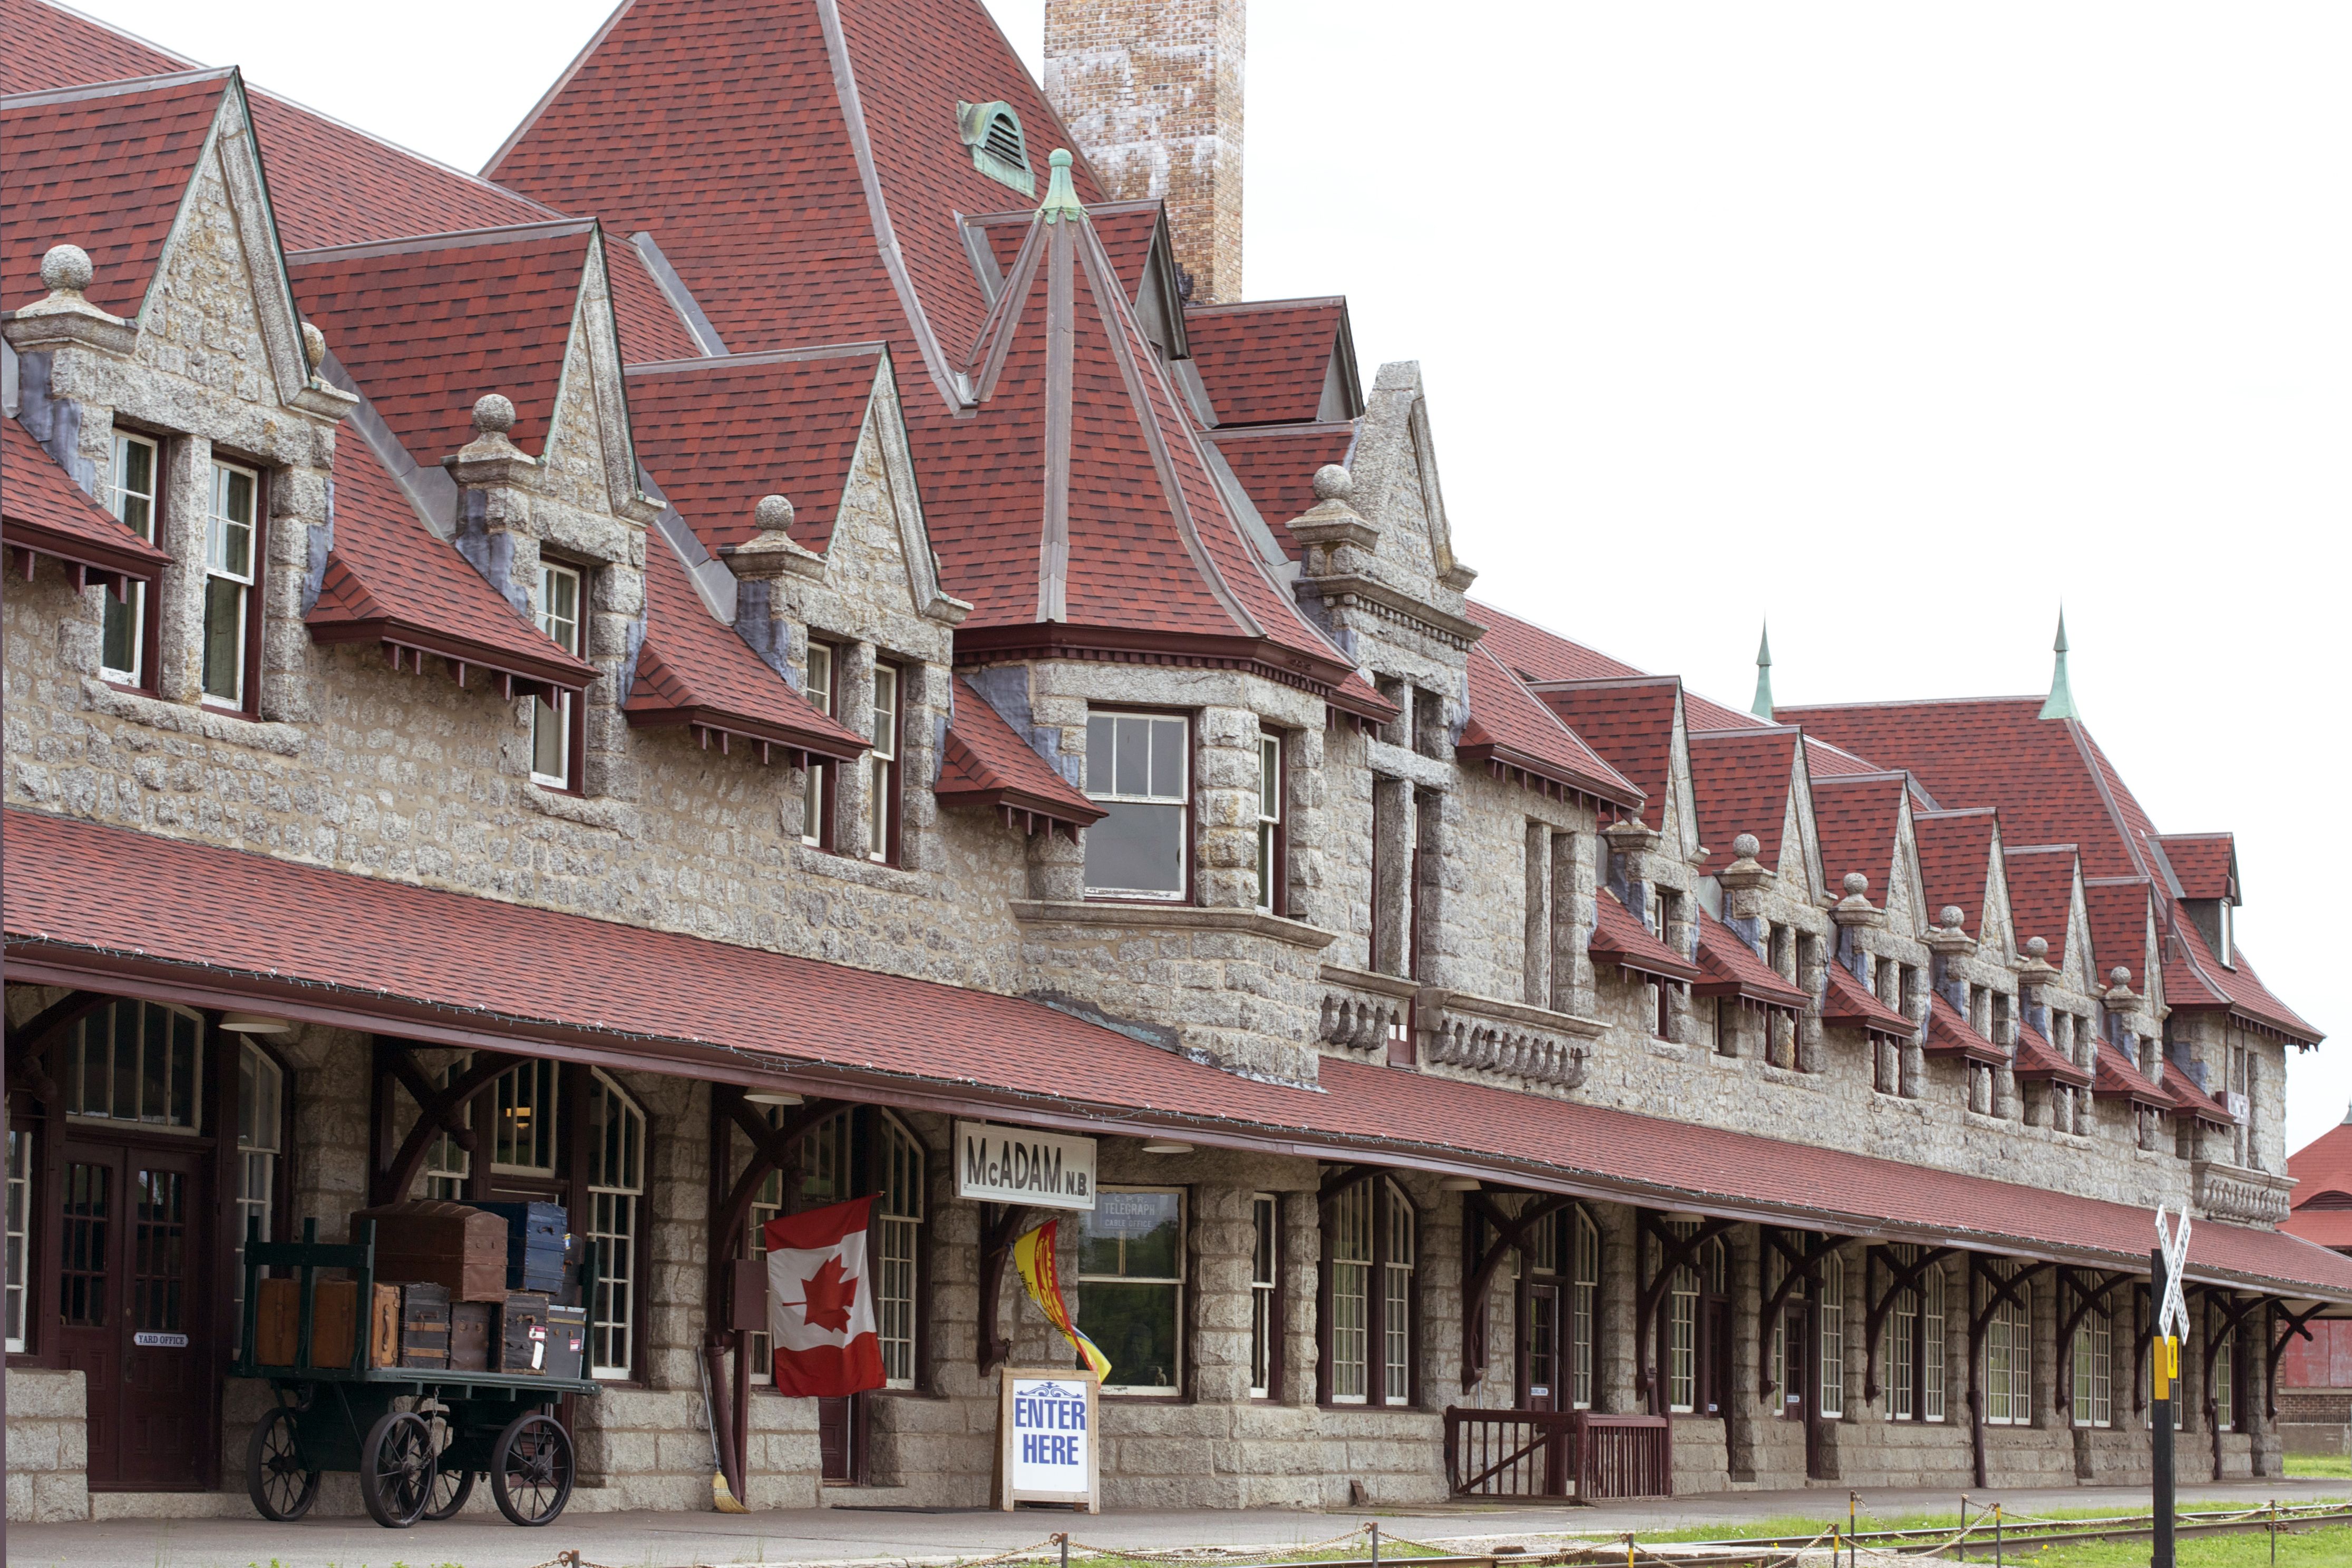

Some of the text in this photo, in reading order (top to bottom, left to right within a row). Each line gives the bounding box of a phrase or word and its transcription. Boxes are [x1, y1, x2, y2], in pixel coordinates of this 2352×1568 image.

[968, 1136, 1089, 1197] McADAM N.B.
[1104, 1203, 1155, 1215] TELEGRAPH
[138, 1335, 184, 1345] YARD OFFICE
[1015, 1397, 1086, 1430] ENTER
[1023, 1434, 1079, 1465] HERE
